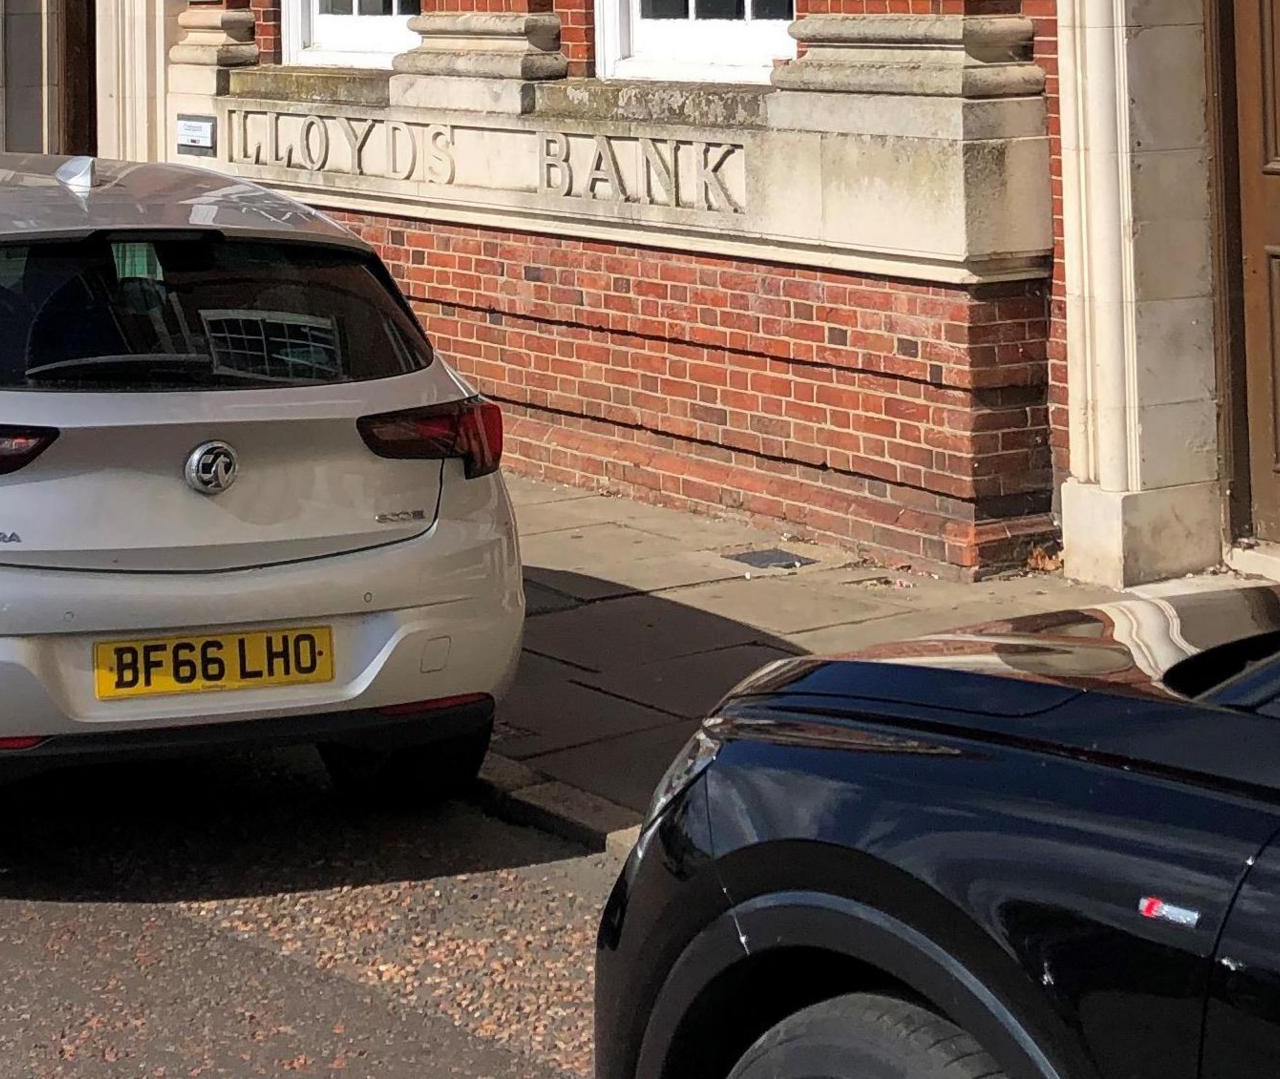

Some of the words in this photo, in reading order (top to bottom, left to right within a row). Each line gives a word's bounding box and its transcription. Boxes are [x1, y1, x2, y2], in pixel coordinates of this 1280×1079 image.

[234, 109, 455, 185] LLOYDS
[536, 130, 746, 215] BANK
[113, 639, 226, 689] BF66
[238, 633, 318, 680] LHO
